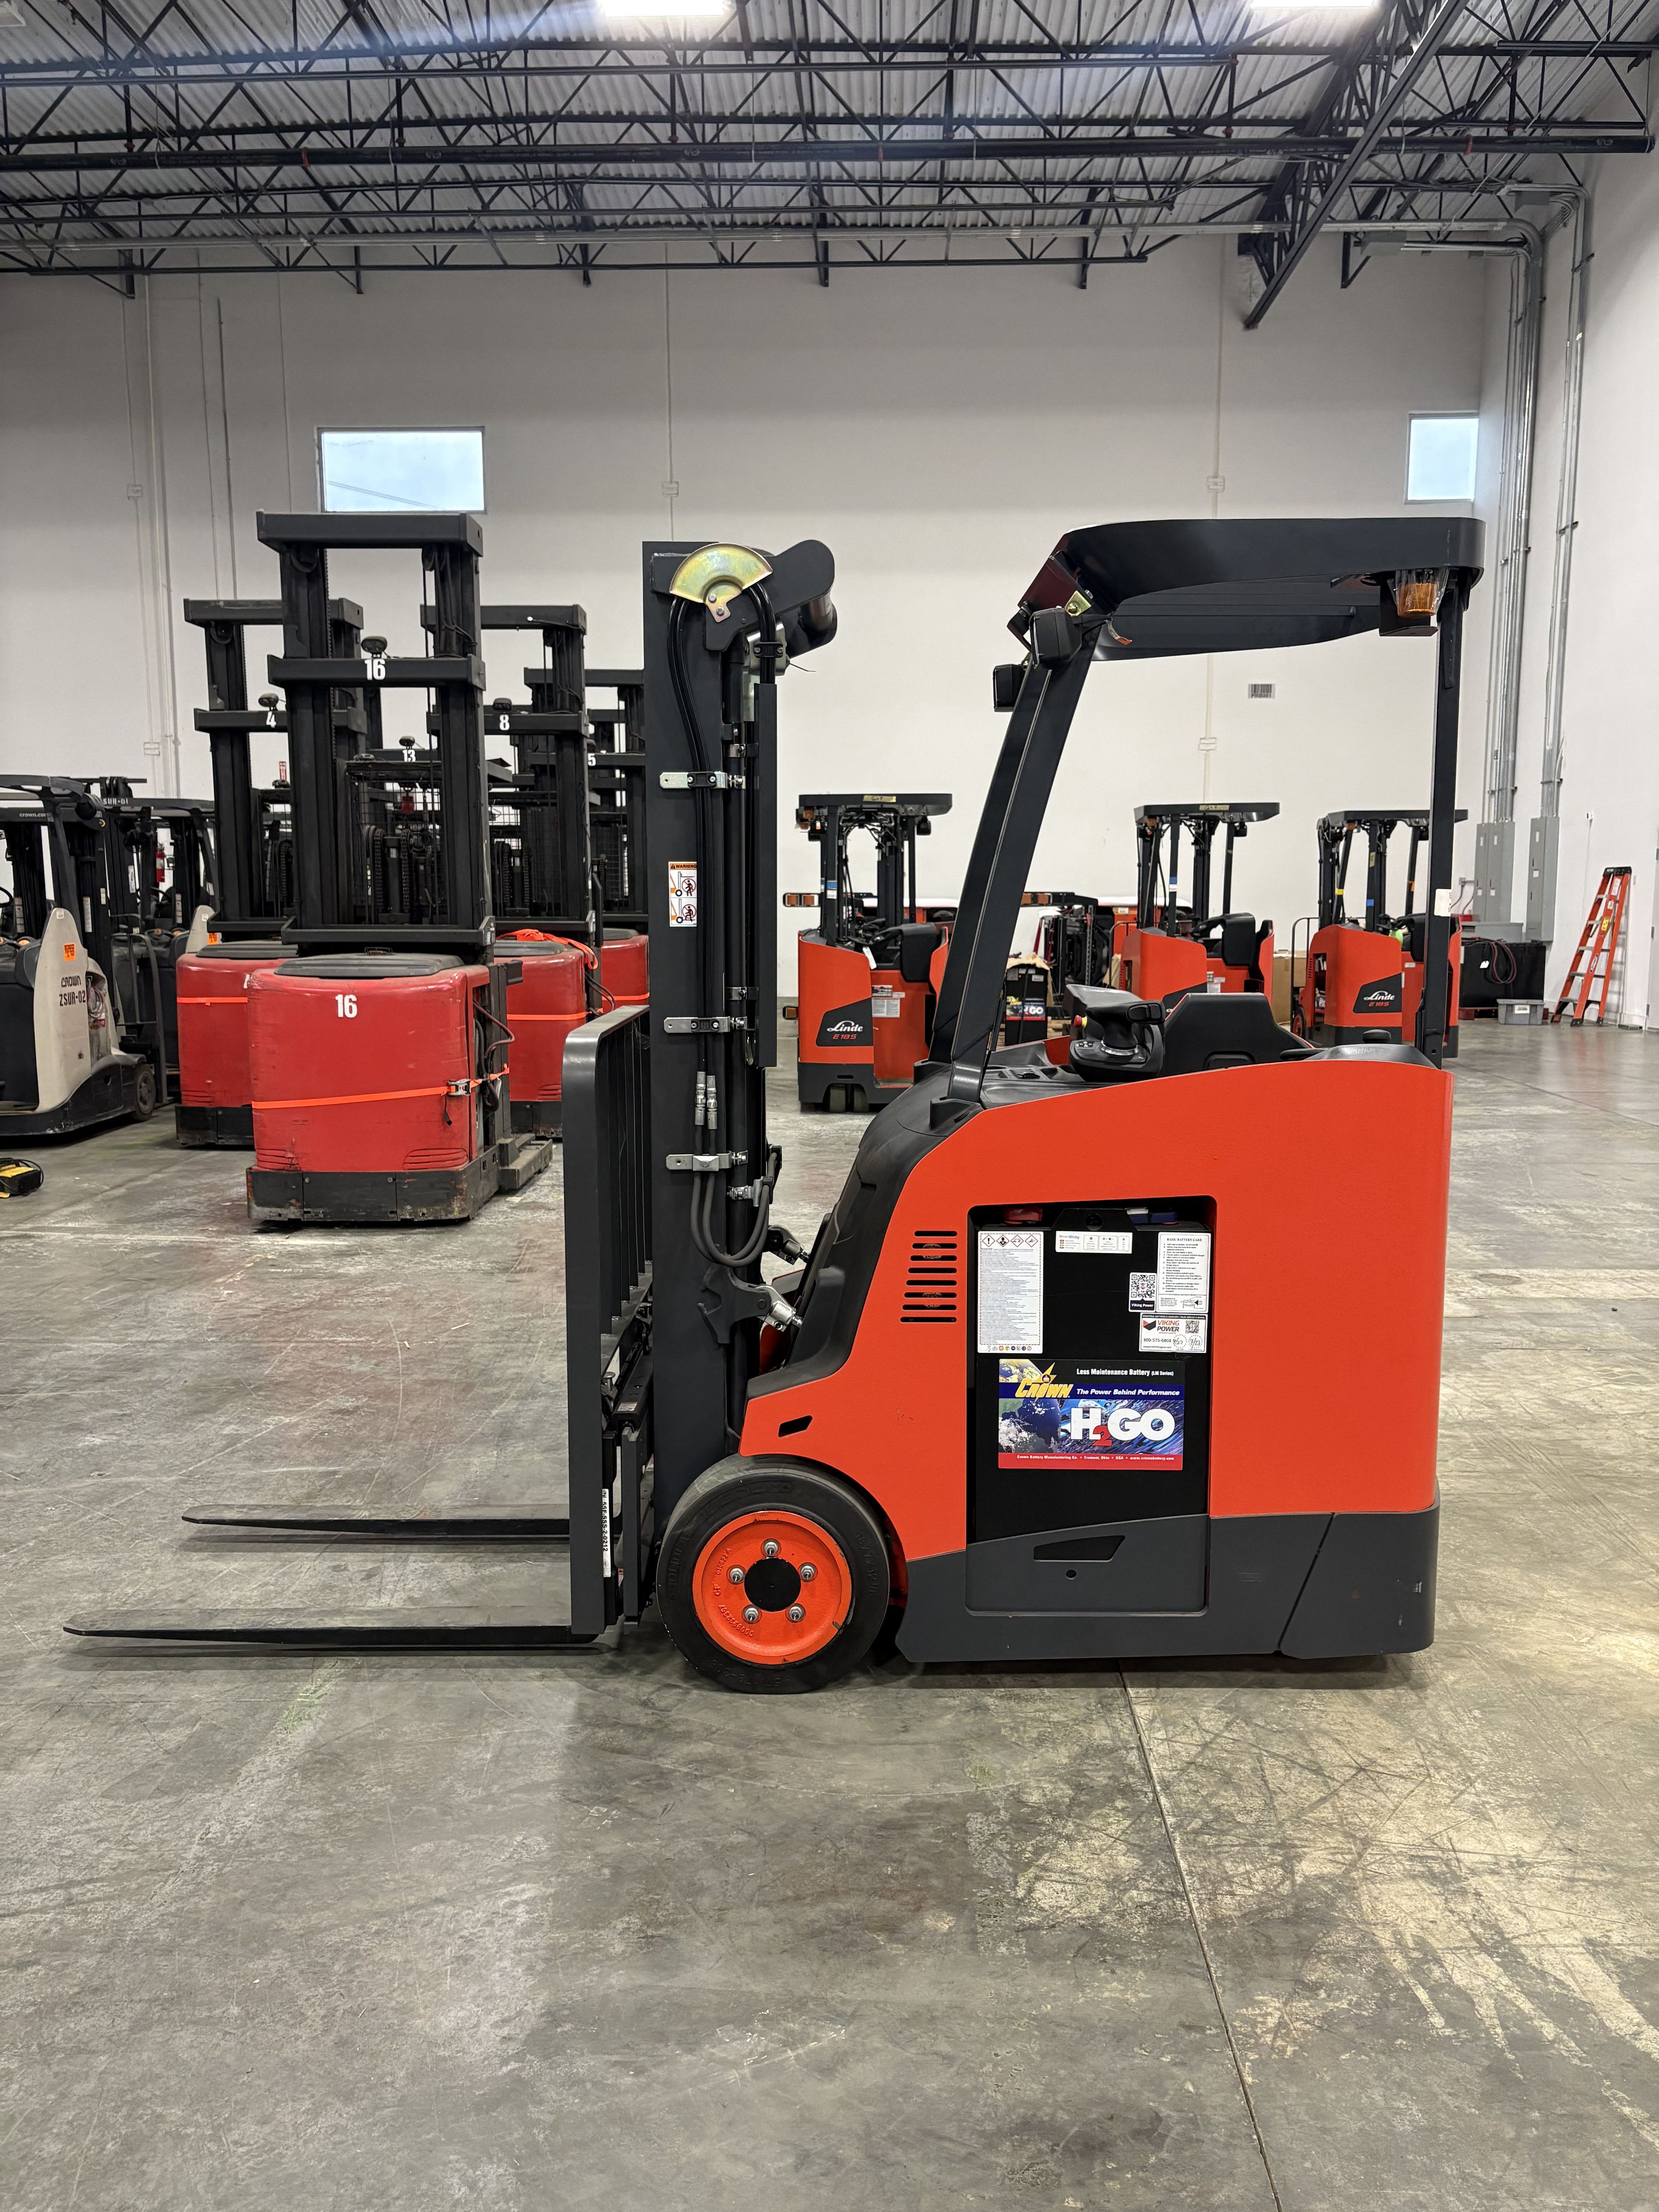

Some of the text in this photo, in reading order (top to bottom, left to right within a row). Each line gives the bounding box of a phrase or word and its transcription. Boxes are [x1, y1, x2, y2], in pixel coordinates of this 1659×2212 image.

[365, 658, 385, 680] 16
[266, 711, 276, 728] 4
[499, 714, 510, 731] 8
[403, 749, 416, 763] 13
[61, 976, 81, 988] CROWN
[1363, 991, 1395, 1001] Linde
[335, 994, 358, 1018] 16
[826, 1020, 863, 1032] Linde
[1015, 1379, 1074, 1398] CROWN
